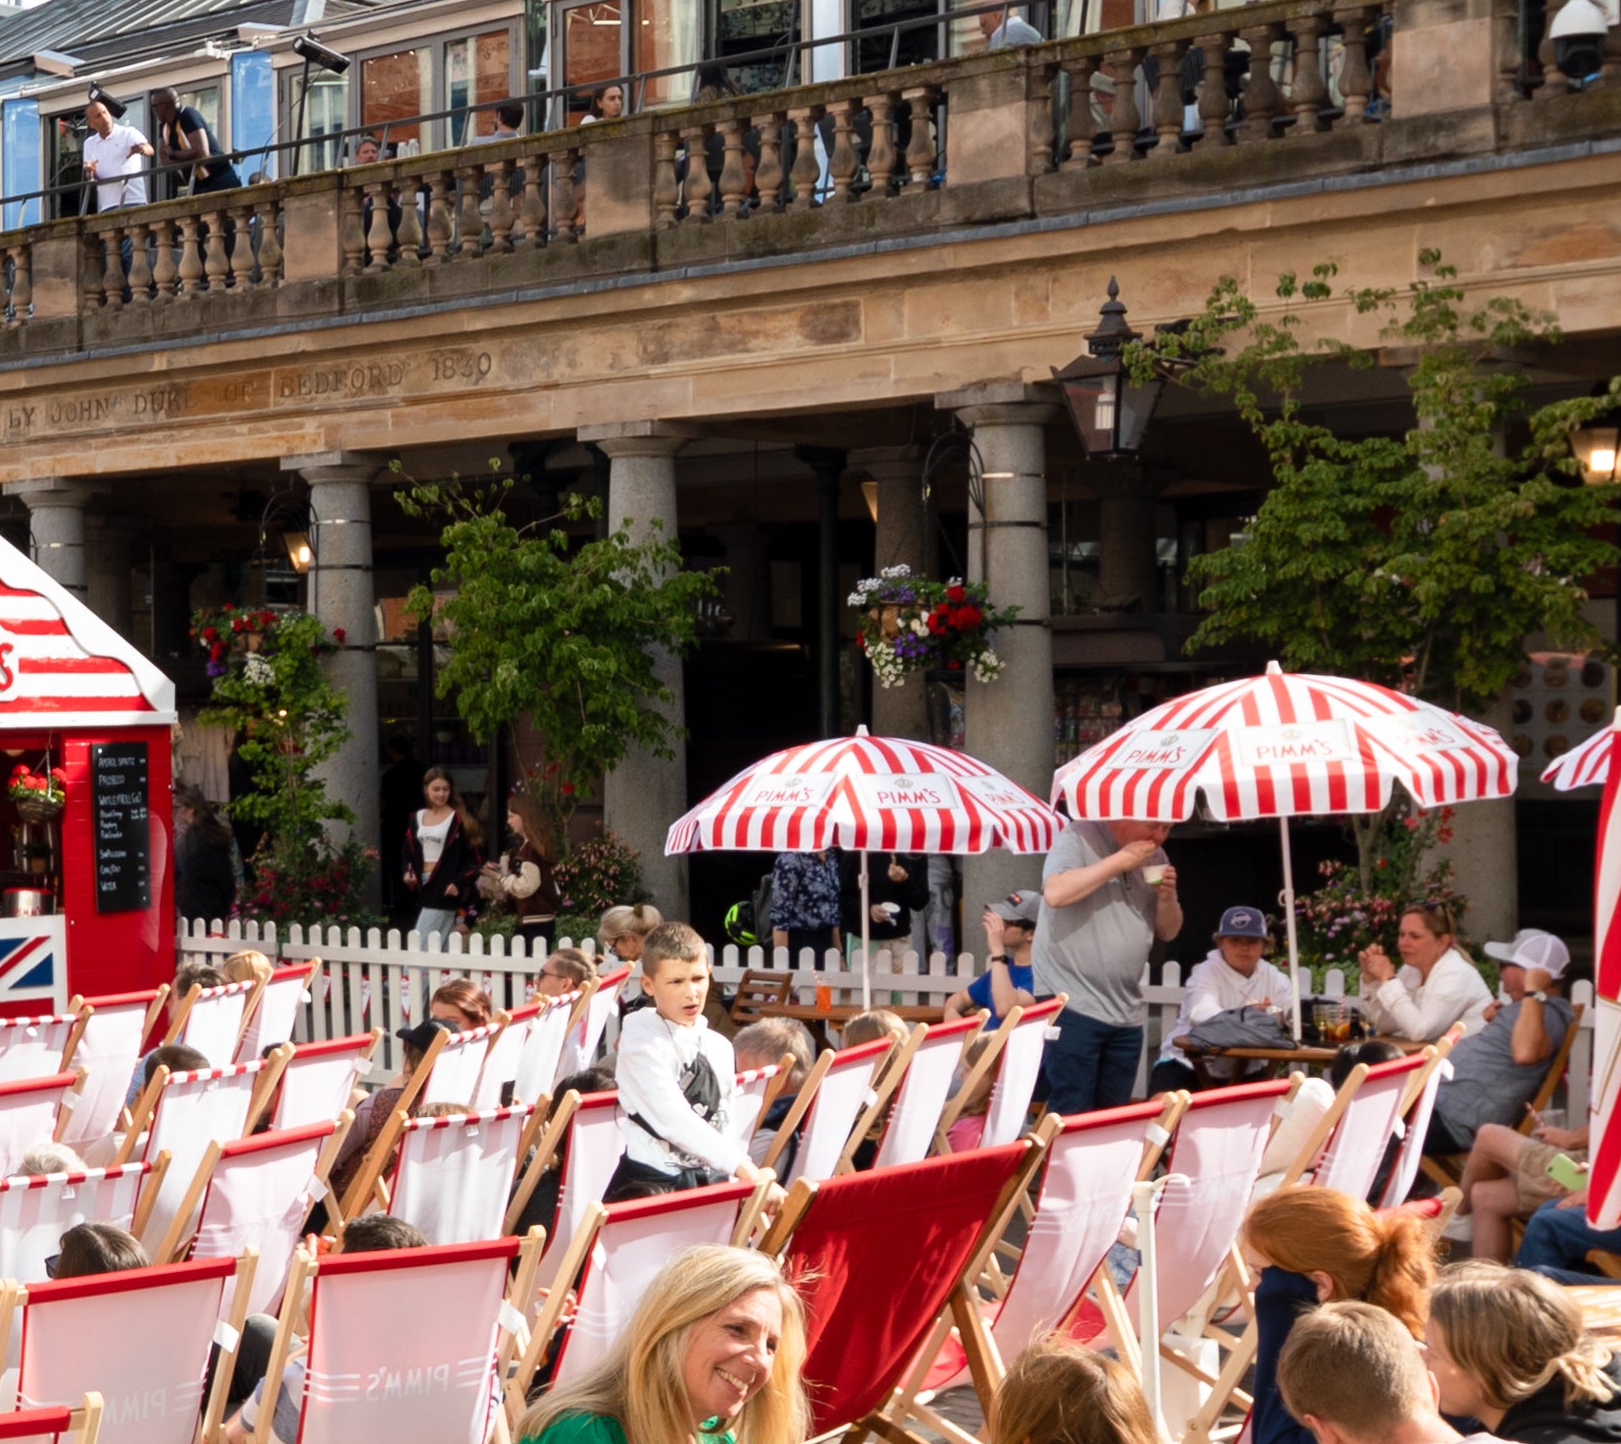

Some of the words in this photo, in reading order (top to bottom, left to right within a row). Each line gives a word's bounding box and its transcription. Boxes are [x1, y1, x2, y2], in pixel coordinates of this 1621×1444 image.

[51, 396, 110, 426] JOHN
[279, 363, 405, 399] BEDFORD
[431, 352, 493, 381] 1830
[1257, 738, 1333, 760] PIMM'S
[876, 788, 942, 804] PIMM'S
